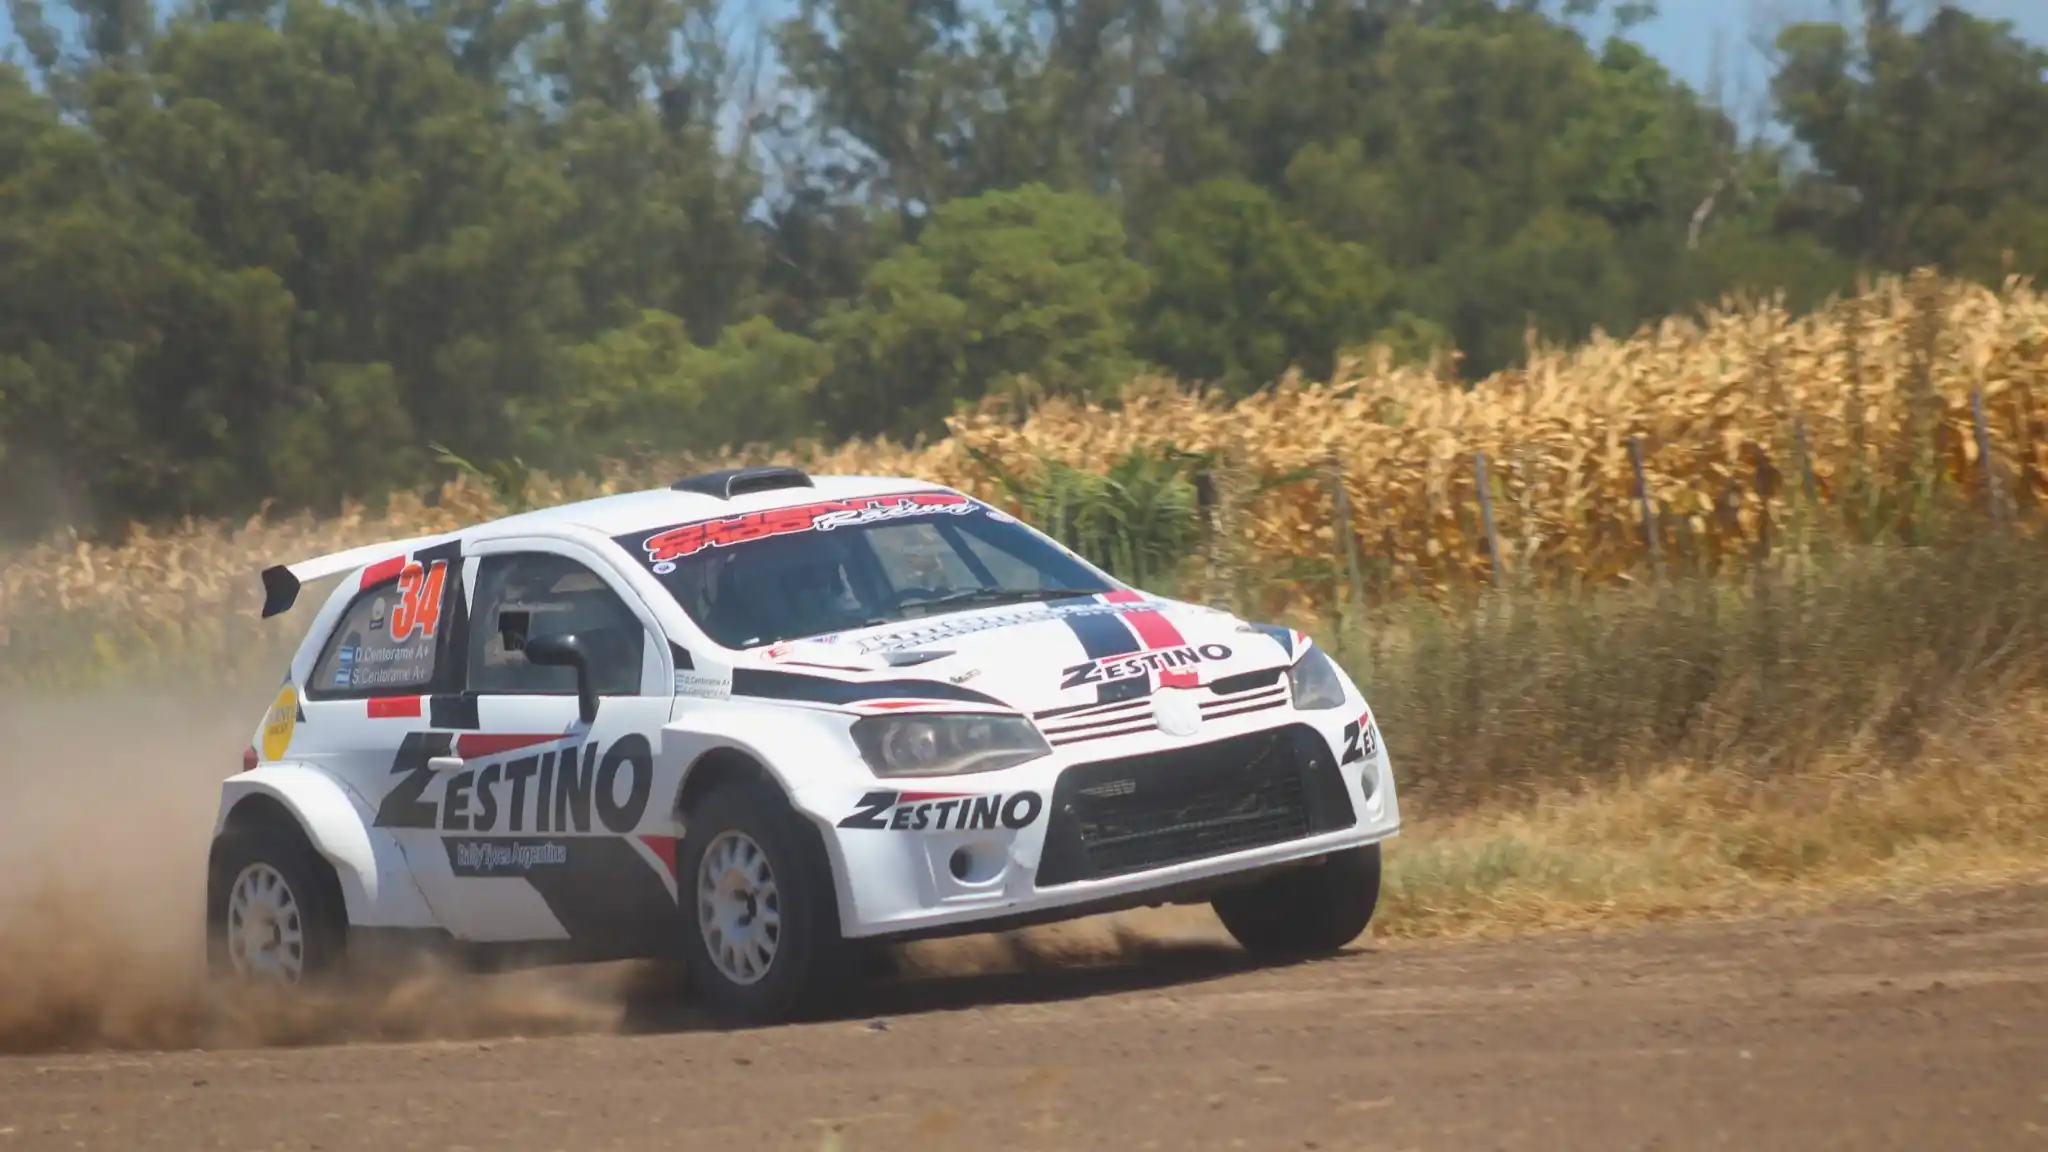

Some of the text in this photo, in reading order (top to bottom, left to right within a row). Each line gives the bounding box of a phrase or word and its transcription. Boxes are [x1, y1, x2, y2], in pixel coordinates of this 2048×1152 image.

[391, 560, 449, 642] 34
[1060, 643, 1232, 690] ZESTINO
[372, 732, 653, 834] ZESTINO
[836, 790, 1043, 830] ZESTINO
